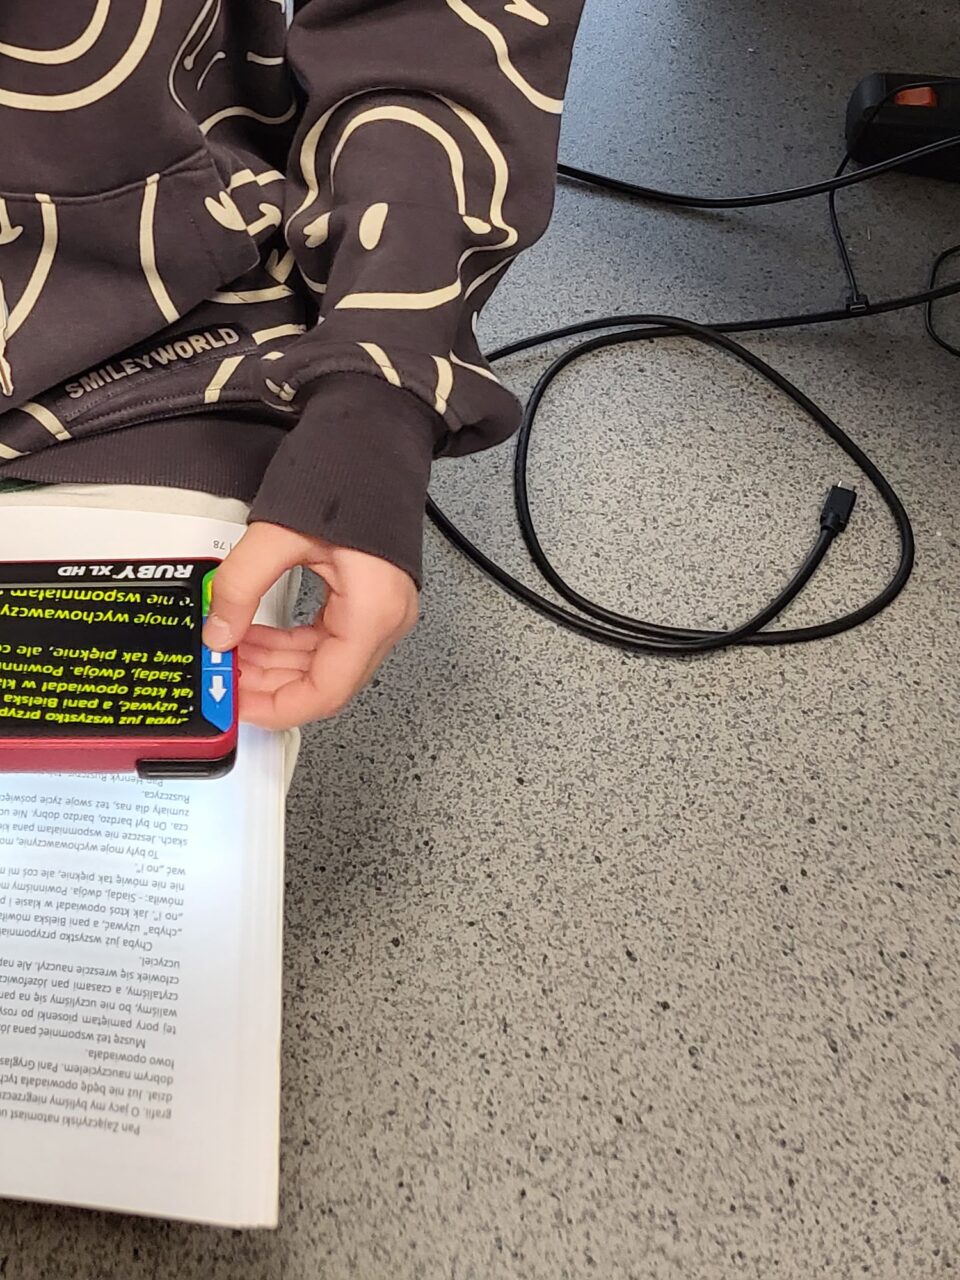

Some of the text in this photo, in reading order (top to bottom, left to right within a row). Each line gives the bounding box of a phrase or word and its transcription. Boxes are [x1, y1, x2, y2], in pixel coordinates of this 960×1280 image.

[64, 327, 240, 400] SMILEYWORLD
[212, 539, 226, 550] 78
[57, 564, 194, 579] RUBY XL HD
[10, 589, 141, 603] wspomniałam
[146, 594, 174, 607] nie
[133, 612, 179, 626] moje
[16, 646, 42, 657] ale
[49, 646, 117, 662] pięknie,
[121, 652, 148, 663] tak
[69, 665, 125, 680] dwója.
[131, 668, 183, 682] Siadaj,
[21, 680, 36, 689] w
[41, 682, 129, 694] opowiadał
[132, 686, 168, 698] ktoś
[3, 694, 58, 708] Bielska
[62, 698, 99, 709] pani
[102, 701, 113, 710] a
[118, 701, 178, 712] używać,
[45, 713, 114, 724] wszystko
[58, 931, 103, 944] wszystko
[105, 936, 120, 950] już
[121, 938, 154, 954] Chyba
[12, 1024, 37, 1035] pana
[38, 1028, 95, 1041] wspomnieć
[96, 1034, 112, 1046] też
[113, 1034, 146, 1051] Muszę
[37, 1061, 59, 1074] Pani
[61, 1064, 132, 1080] nauczycielem.
[134, 1072, 174, 1089] dobrym
